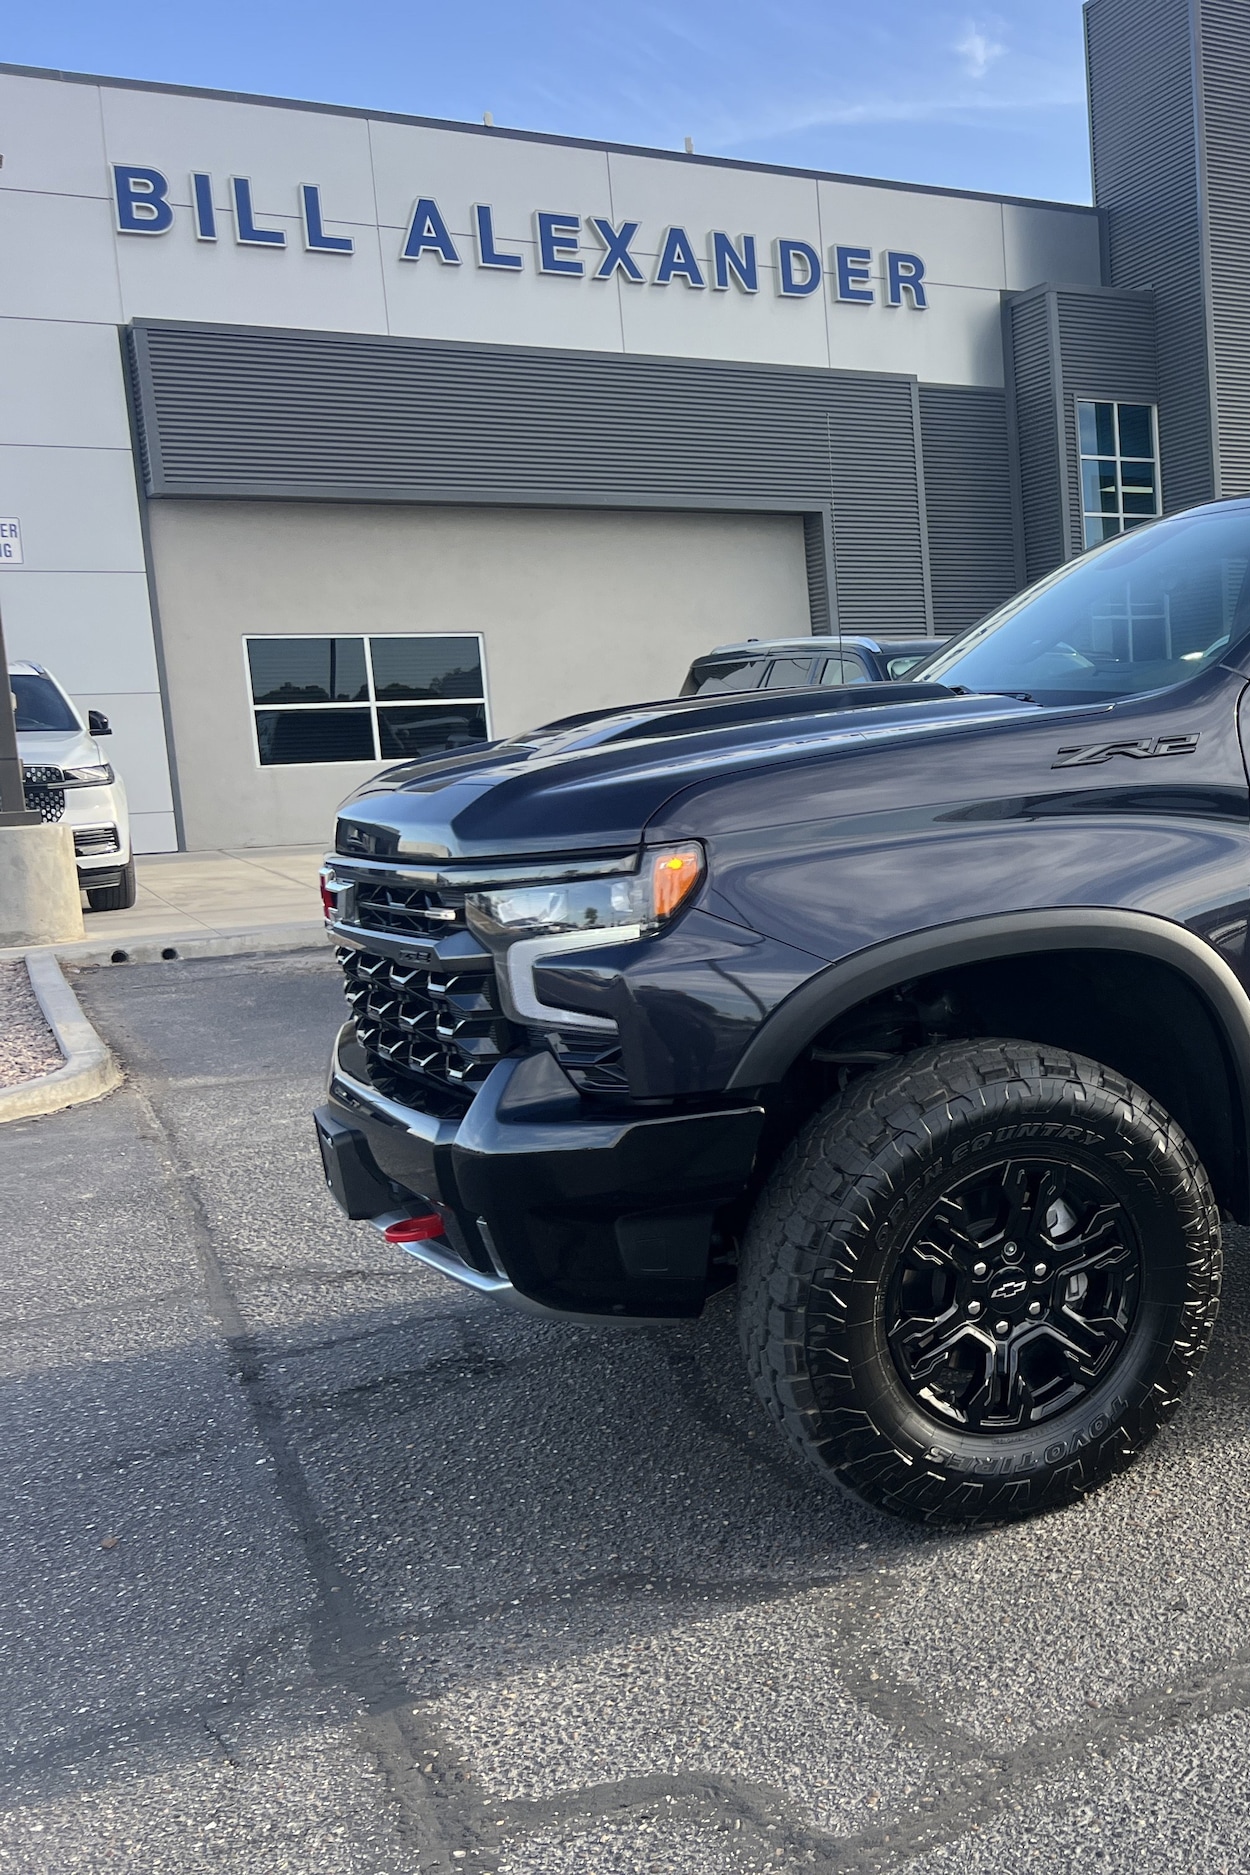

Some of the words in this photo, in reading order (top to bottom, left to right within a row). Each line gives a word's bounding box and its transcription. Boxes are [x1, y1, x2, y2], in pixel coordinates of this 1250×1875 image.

[110, 162, 355, 256] BILL
[400, 195, 929, 310] ALEXANDER
[1051, 732, 1201, 769] ZR2
[950, 1121, 1107, 1165] COUNTRY
[1043, 1394, 1129, 1466] TOYO
[921, 1444, 1040, 1476] TIRES
